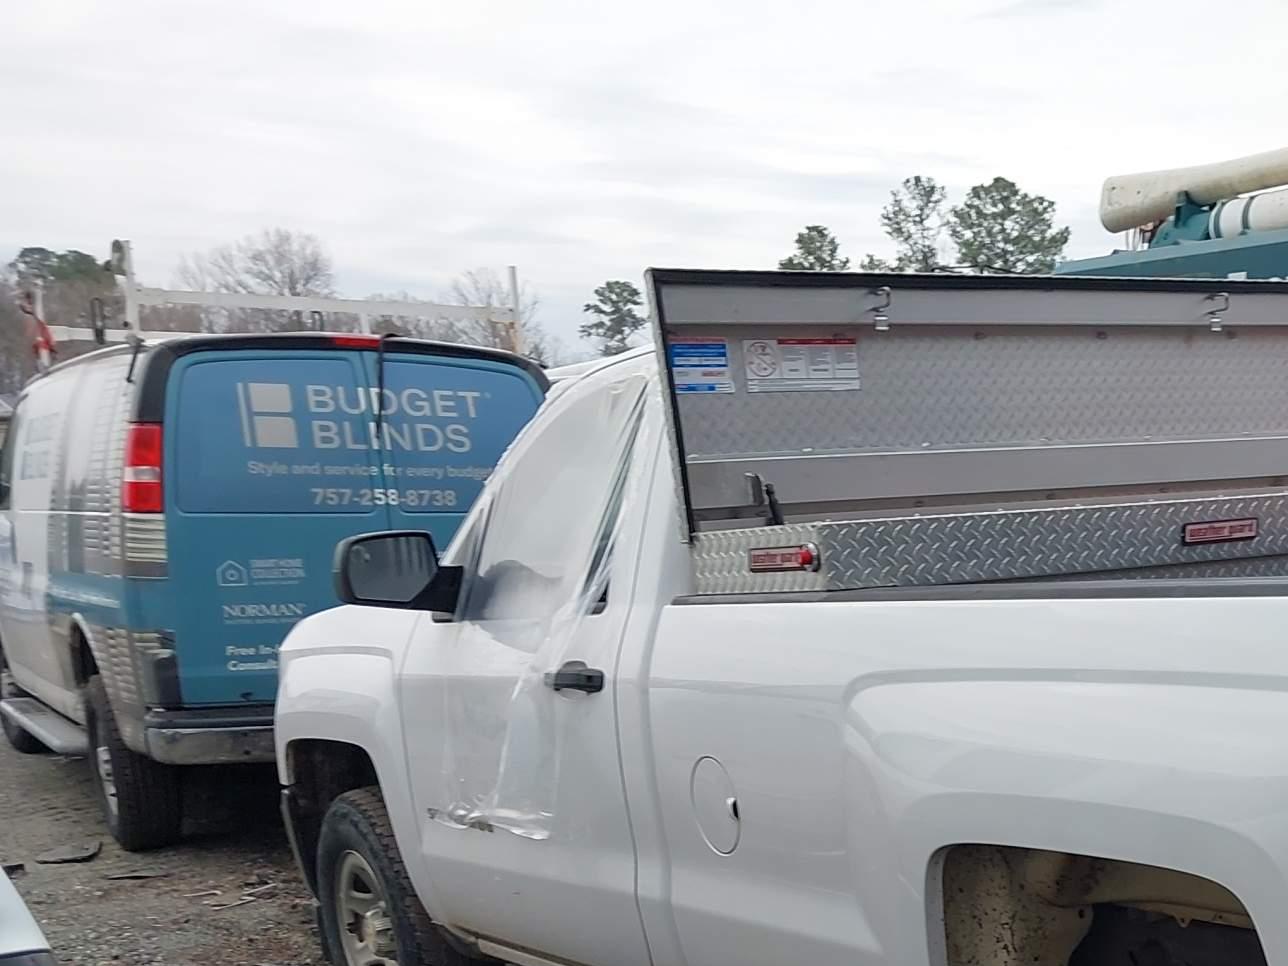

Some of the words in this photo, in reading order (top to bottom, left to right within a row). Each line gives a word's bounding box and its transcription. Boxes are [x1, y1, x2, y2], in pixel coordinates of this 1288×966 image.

[305, 384, 481, 418] BUDGET
[311, 419, 472, 453] BLINDS
[292, 461, 320, 475] and
[406, 466, 443, 480] every
[311, 488, 457, 506] 757-258-8738
[222, 603, 304, 617] NORMAN
